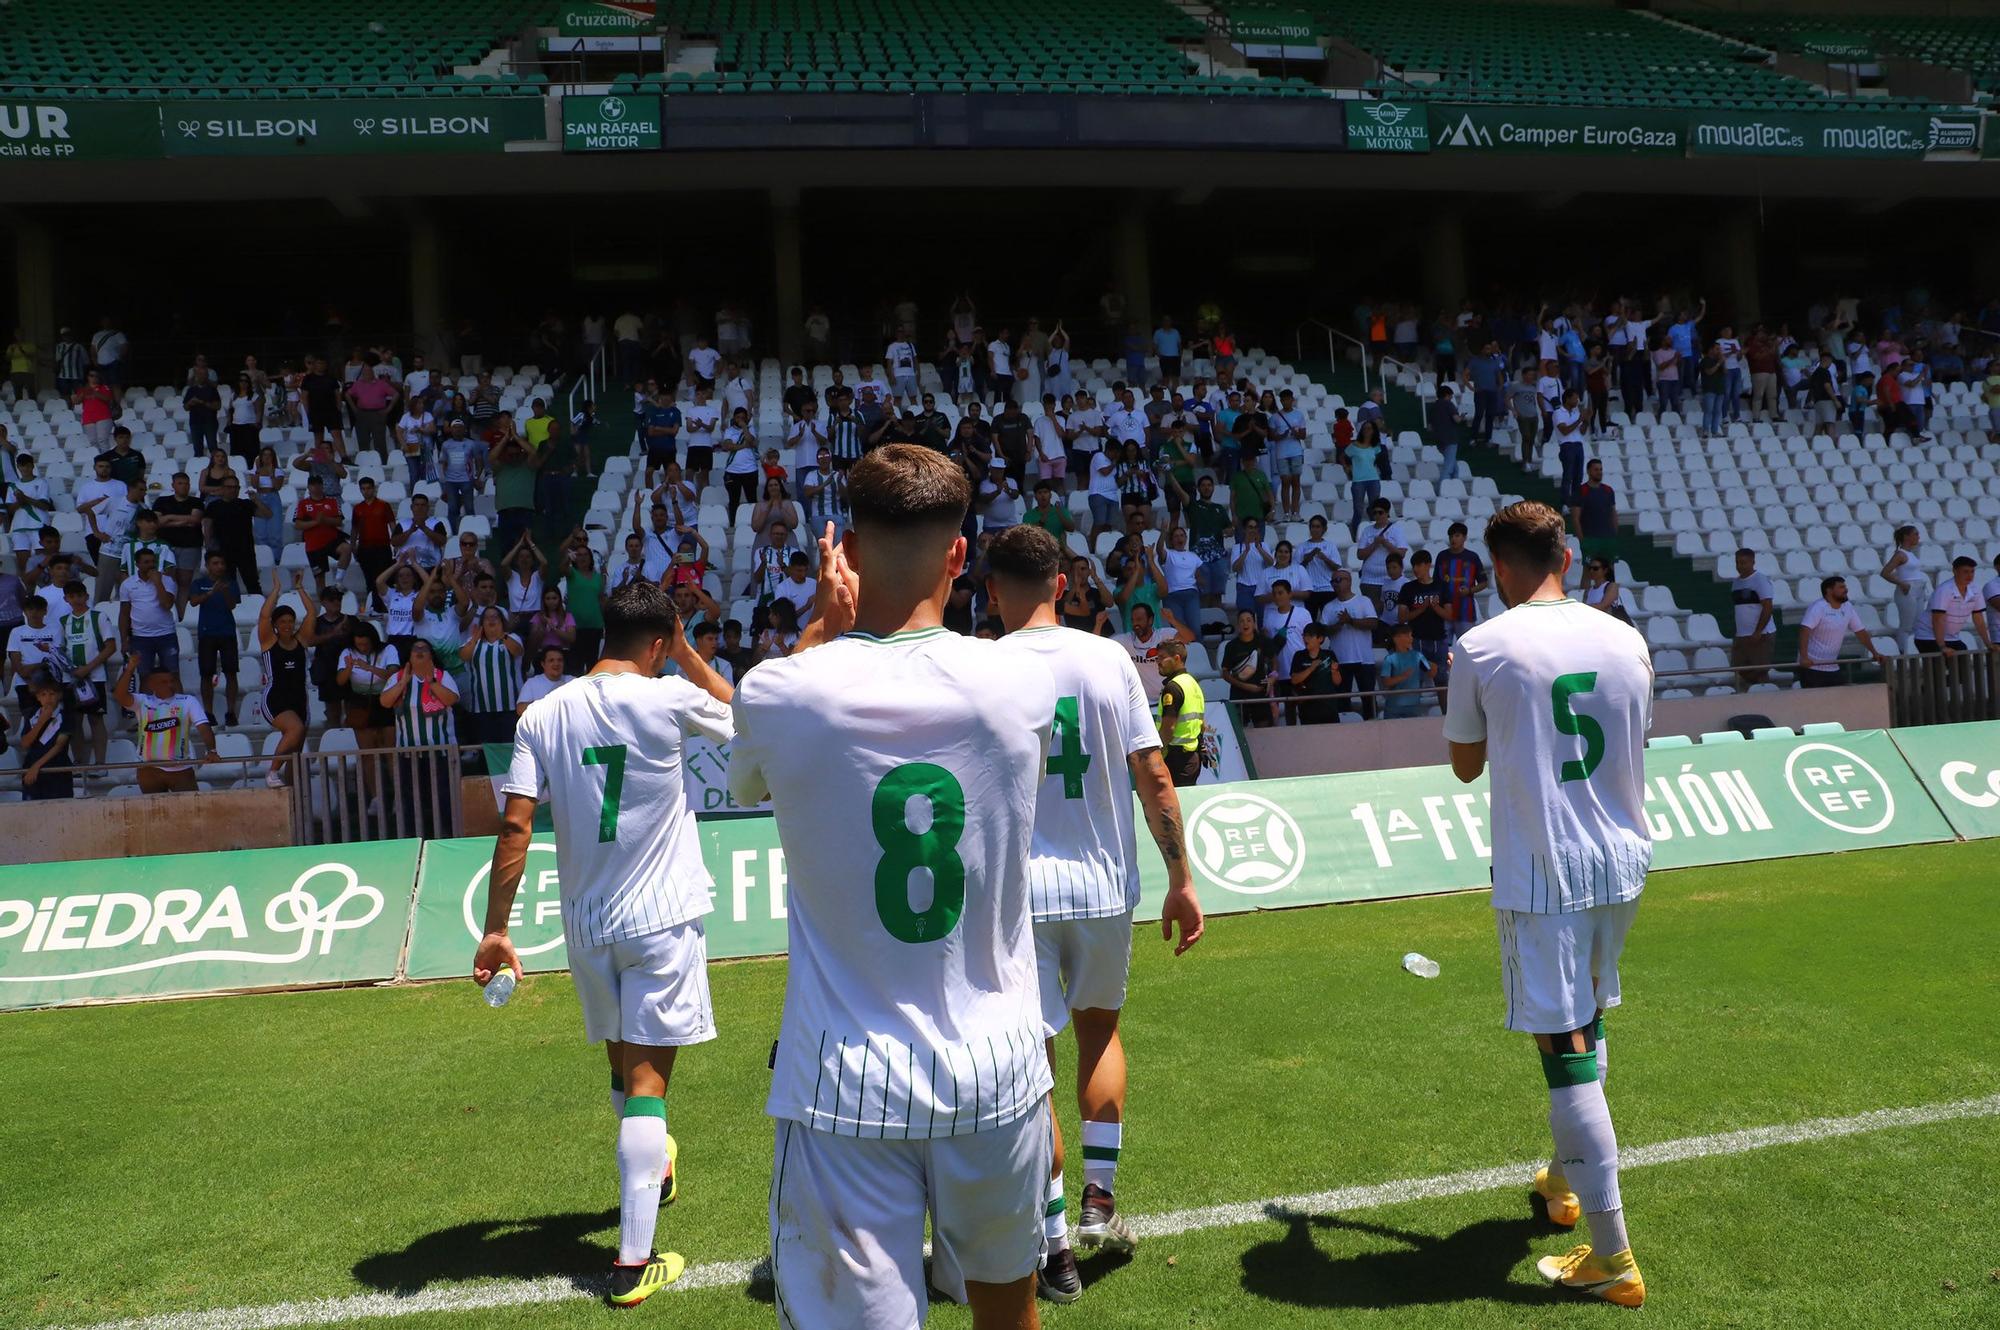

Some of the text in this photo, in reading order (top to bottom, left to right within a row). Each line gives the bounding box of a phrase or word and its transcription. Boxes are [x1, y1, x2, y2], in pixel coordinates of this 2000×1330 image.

[206, 119, 318, 137] SILBON
[381, 116, 490, 136] SILBON
[566, 122, 658, 135] SAN RAFAEL
[1347, 125, 1428, 138] SAN RAFAEL
[585, 135, 639, 148] MOTOR
[1499, 122, 1677, 147] Camper EuroGaza
[1938, 137, 1971, 145] GALIOT
[30, 143, 51, 156] de
[55, 144, 75, 156] FP
[1366, 137, 1414, 150] MOTOR
[304, 504, 314, 512] 15
[148, 719, 177, 731] PILSENER
[1551, 671, 1605, 783] 5
[1046, 696, 1091, 799] 4
[1803, 764, 1856, 786] RF
[580, 744, 627, 843] 7
[1819, 789, 1872, 812] EF
[1224, 826, 1260, 842] RF
[872, 763, 965, 943] 8
[1229, 843, 1265, 859] EF
